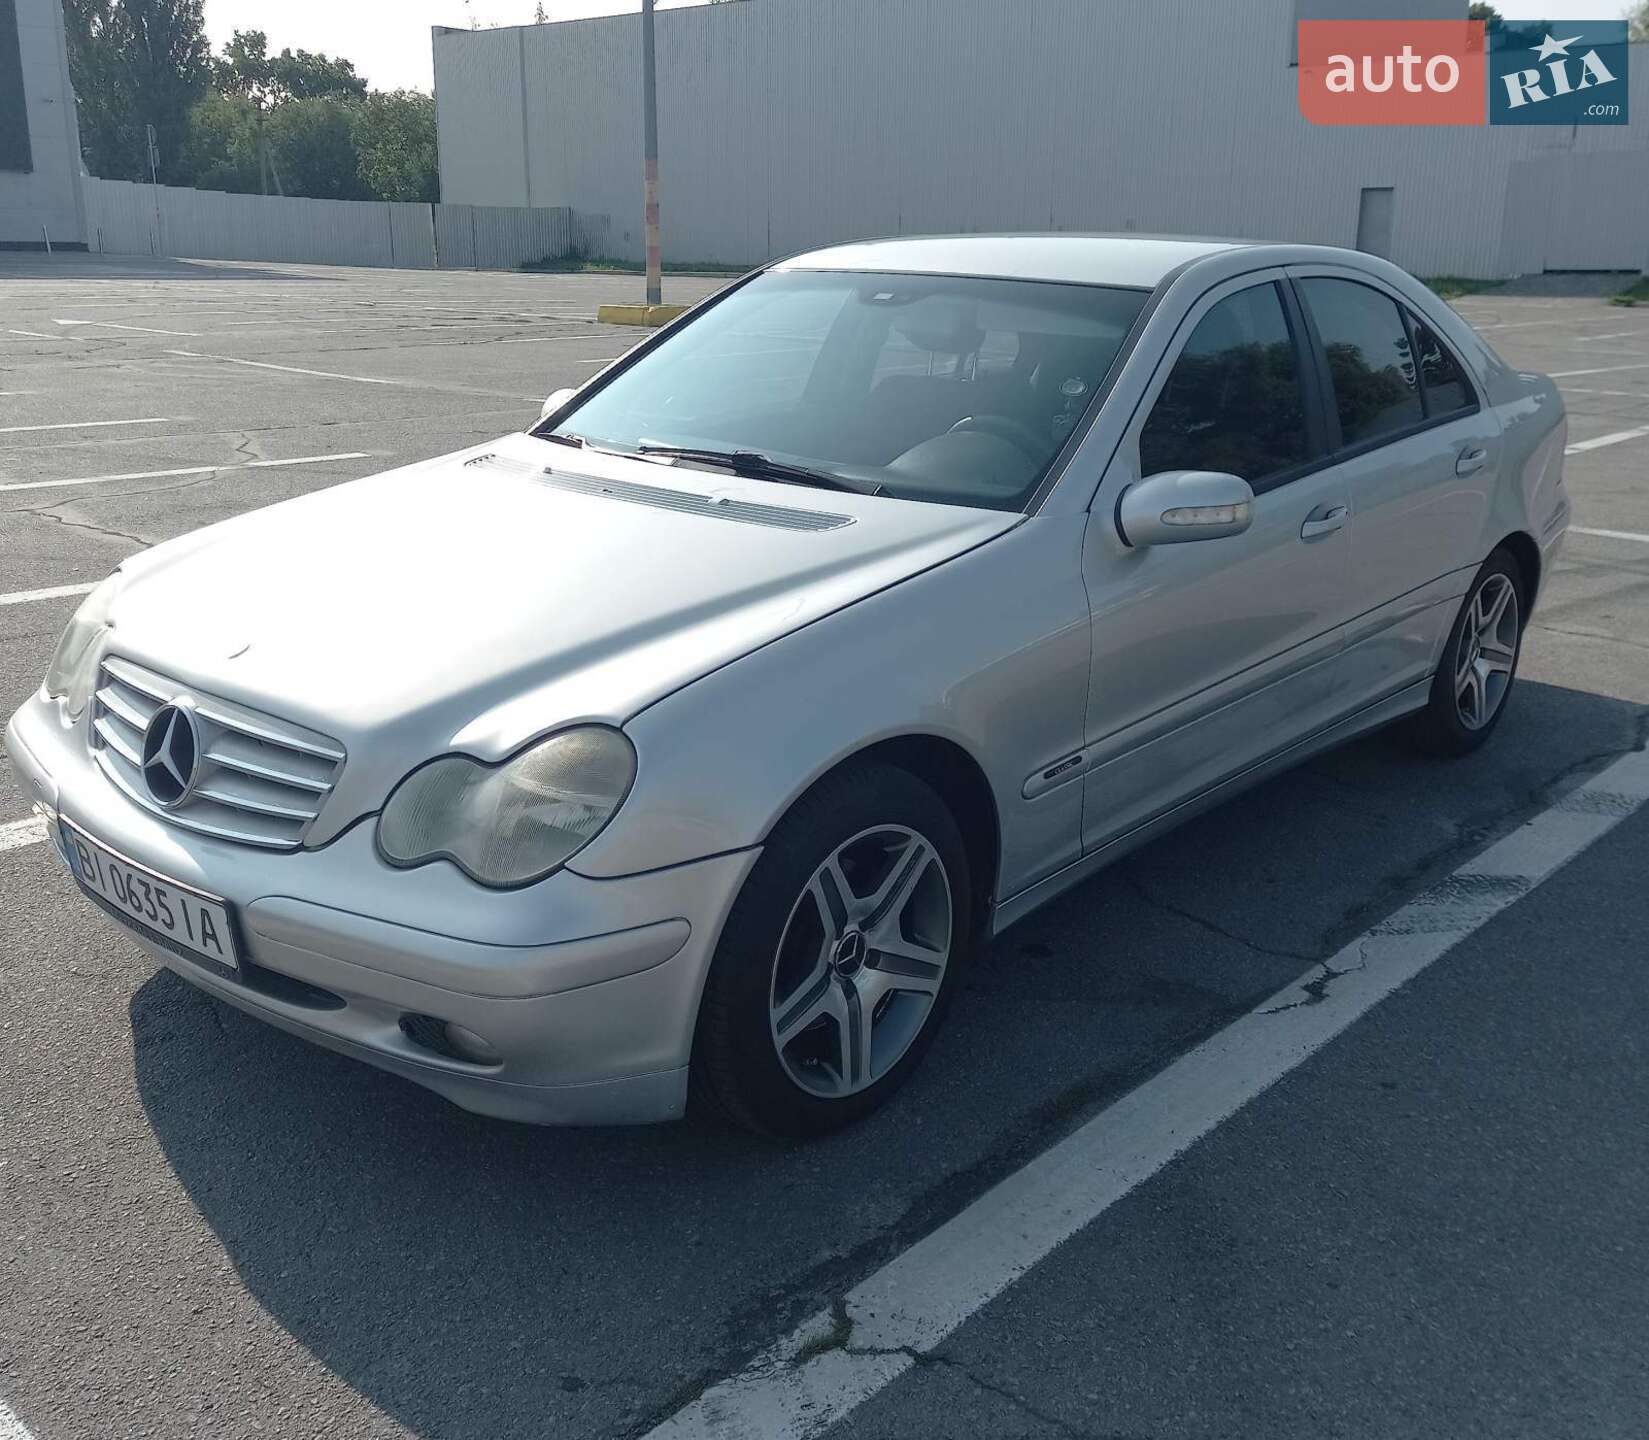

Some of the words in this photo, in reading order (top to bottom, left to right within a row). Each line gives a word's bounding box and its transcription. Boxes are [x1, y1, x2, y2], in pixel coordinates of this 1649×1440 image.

[75, 839, 106, 891] BI
[109, 864, 174, 930] 0635
[181, 899, 223, 954] IA
